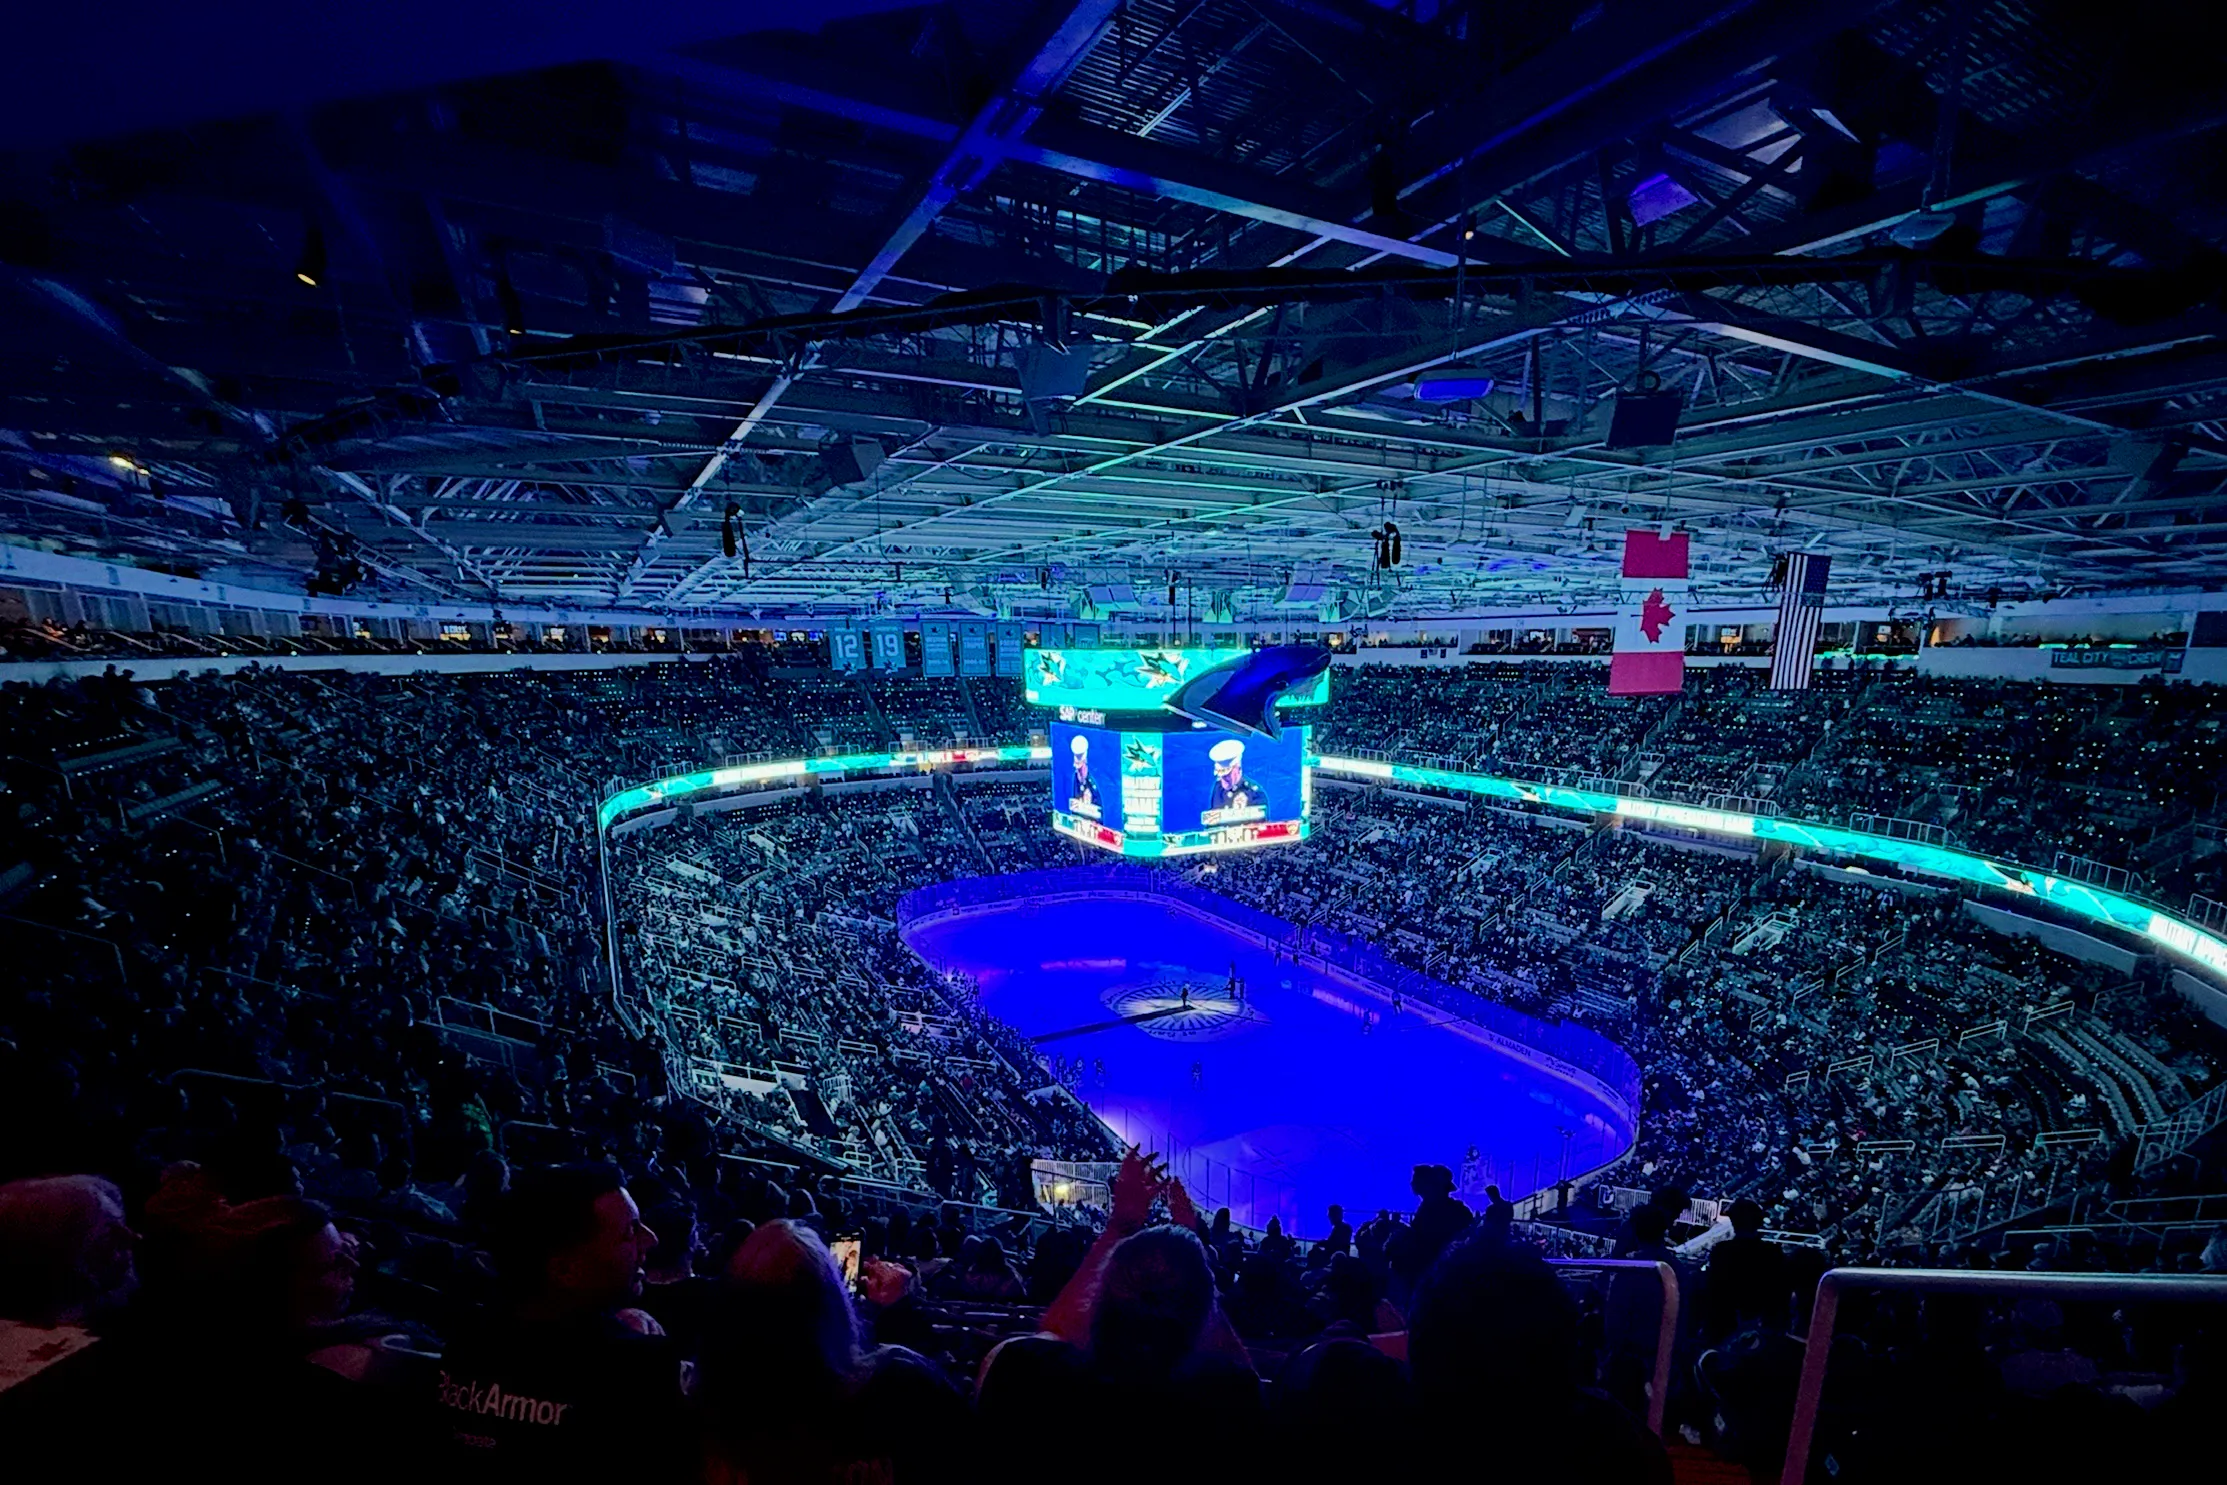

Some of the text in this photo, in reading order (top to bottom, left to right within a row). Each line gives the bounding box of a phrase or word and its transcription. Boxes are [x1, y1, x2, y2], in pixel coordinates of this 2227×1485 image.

[835, 634, 859, 659] 12
[876, 634, 900, 657] 19
[2053, 652, 2079, 663] TEAL
[2083, 652, 2108, 663] CITY
[1059, 705, 1075, 721] SAP
